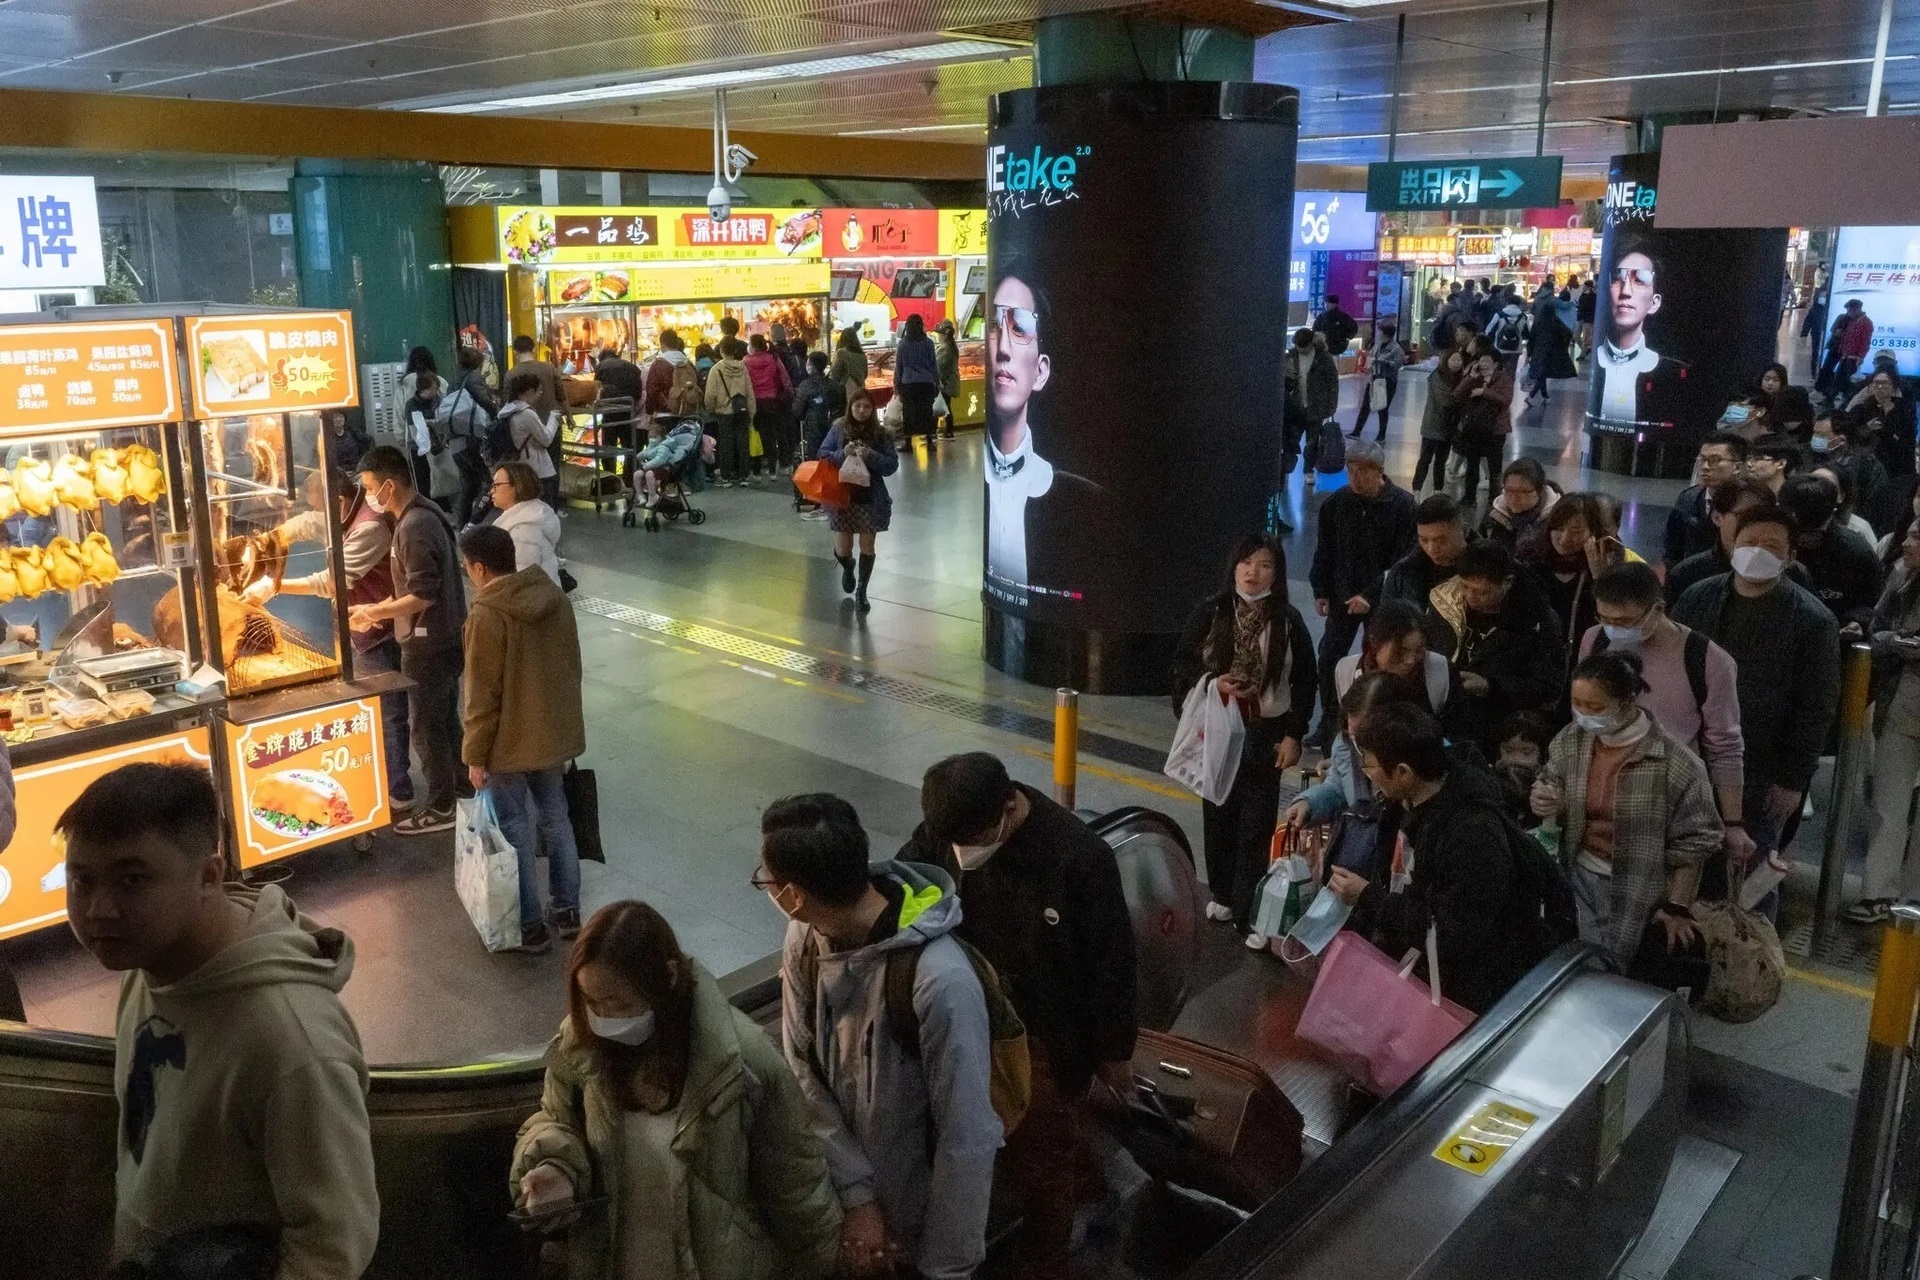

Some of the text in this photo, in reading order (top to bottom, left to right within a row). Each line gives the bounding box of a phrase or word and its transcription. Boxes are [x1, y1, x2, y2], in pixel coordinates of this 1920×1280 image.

[1076, 146, 1091, 156] 2.0
[1400, 168, 1442, 188] 出口
[1399, 189, 1440, 204] EXIT
[0, 195, 77, 268] 牌
[565, 216, 650, 245] 一品鸡
[692, 218, 767, 242] 深井烧鸭
[1888, 339, 1917, 348] 8388
[245, 711, 370, 763] 金牌脆皮烧猪
